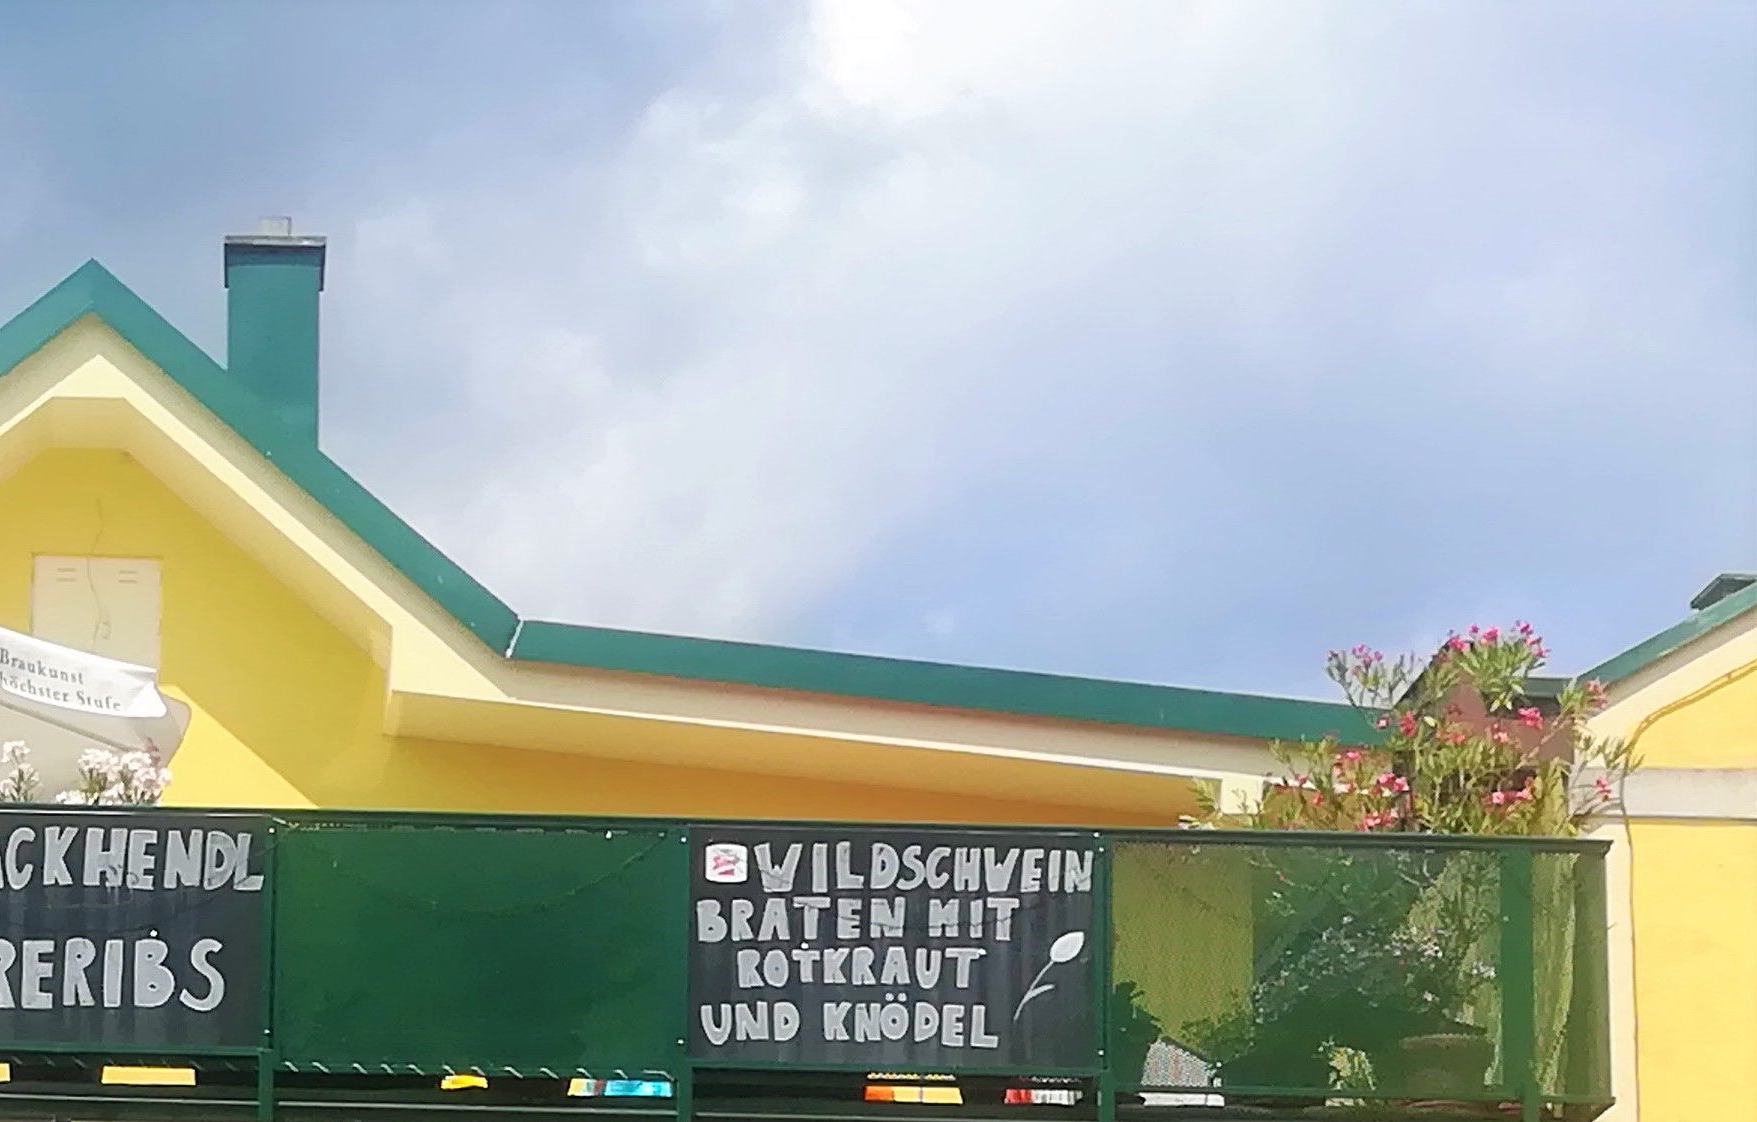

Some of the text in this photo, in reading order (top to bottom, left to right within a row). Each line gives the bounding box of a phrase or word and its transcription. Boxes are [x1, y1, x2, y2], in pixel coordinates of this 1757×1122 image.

[0, 647, 84, 685] Braukunst
[754, 840, 1093, 894] WILDSCHWEIN
[697, 897, 1020, 943] BRATEN MIT
[737, 946, 986, 988] ROTKRAUT
[700, 992, 999, 1049] UND KNÖDEL
